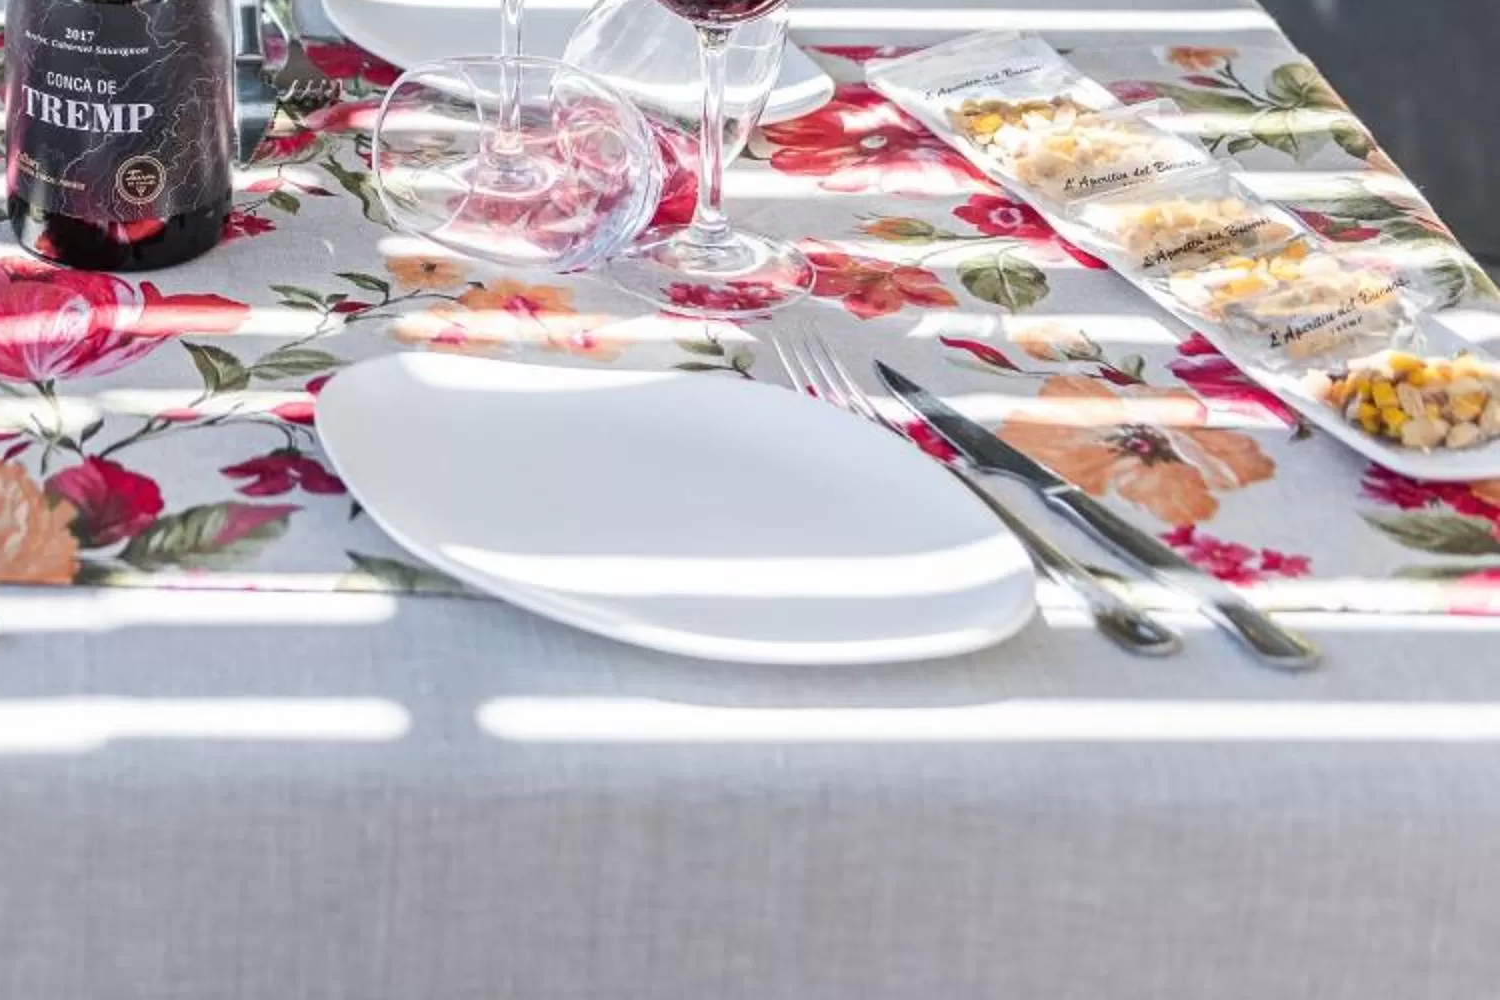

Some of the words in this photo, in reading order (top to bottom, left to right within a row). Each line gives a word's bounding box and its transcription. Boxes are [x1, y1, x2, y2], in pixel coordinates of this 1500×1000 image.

[65, 27, 95, 42] 2017
[46, 72, 93, 93] CONCA
[97, 80, 117, 95] DE
[22, 83, 154, 133] TREMP
[1134, 165, 1152, 176] del
[1338, 297, 1356, 315] del
